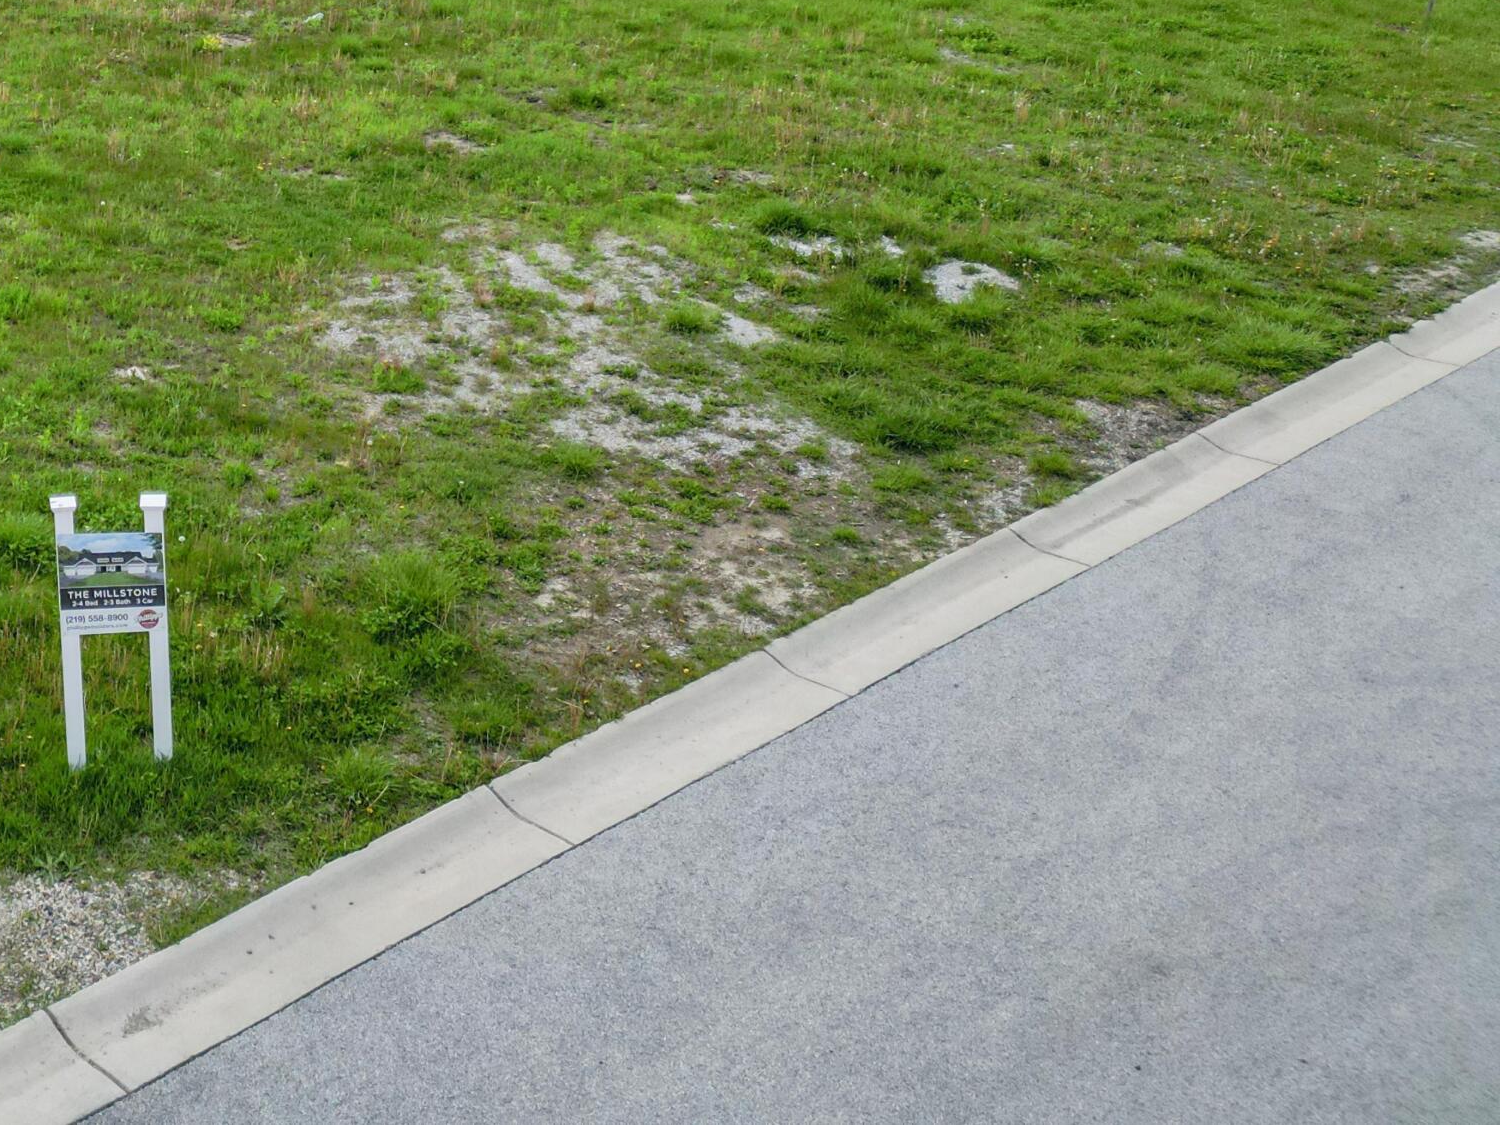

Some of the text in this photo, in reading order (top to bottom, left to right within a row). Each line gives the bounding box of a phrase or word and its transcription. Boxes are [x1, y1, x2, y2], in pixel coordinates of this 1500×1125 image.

[68, 588, 158, 599] THE MILLSTONE
[66, 615, 85, 624] (219)
